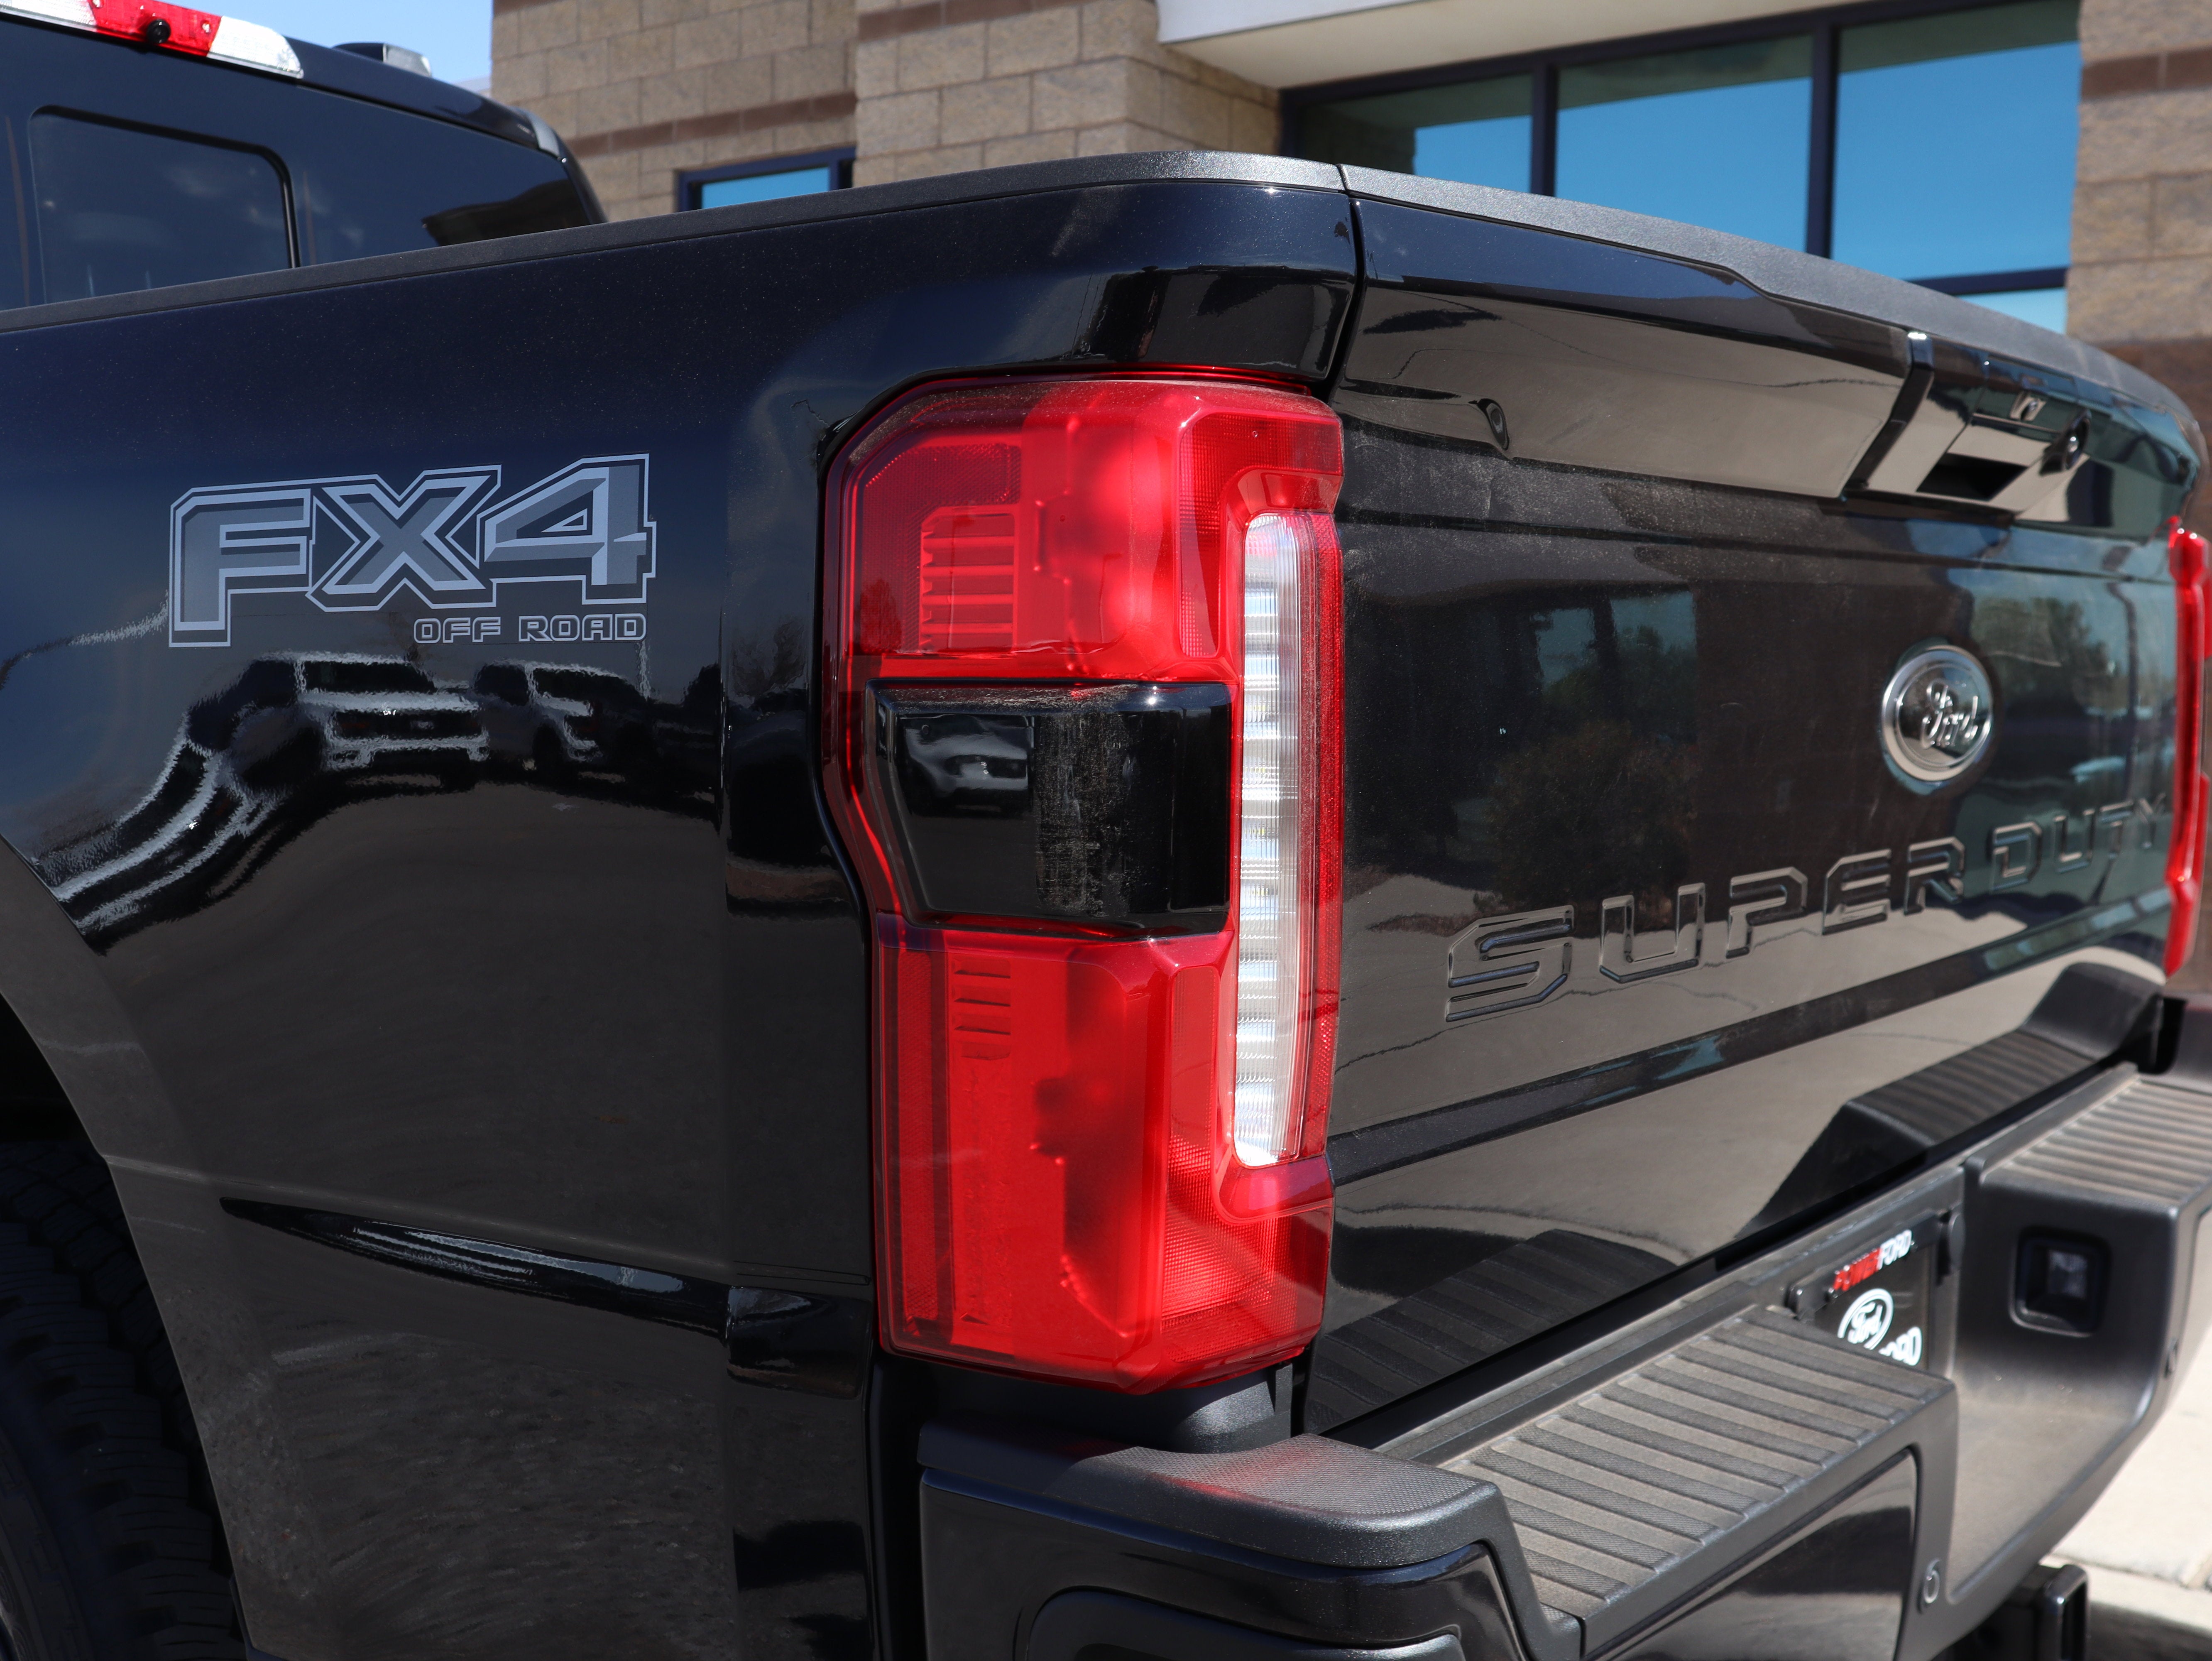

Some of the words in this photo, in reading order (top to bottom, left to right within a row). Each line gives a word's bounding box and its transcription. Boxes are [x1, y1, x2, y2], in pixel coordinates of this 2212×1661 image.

[168, 453, 656, 647] FX4
[414, 616, 501, 643] OFF
[519, 613, 646, 642] ROAD
[1445, 836, 1965, 1023] SUPER
[1991, 792, 2167, 891] DUTY
